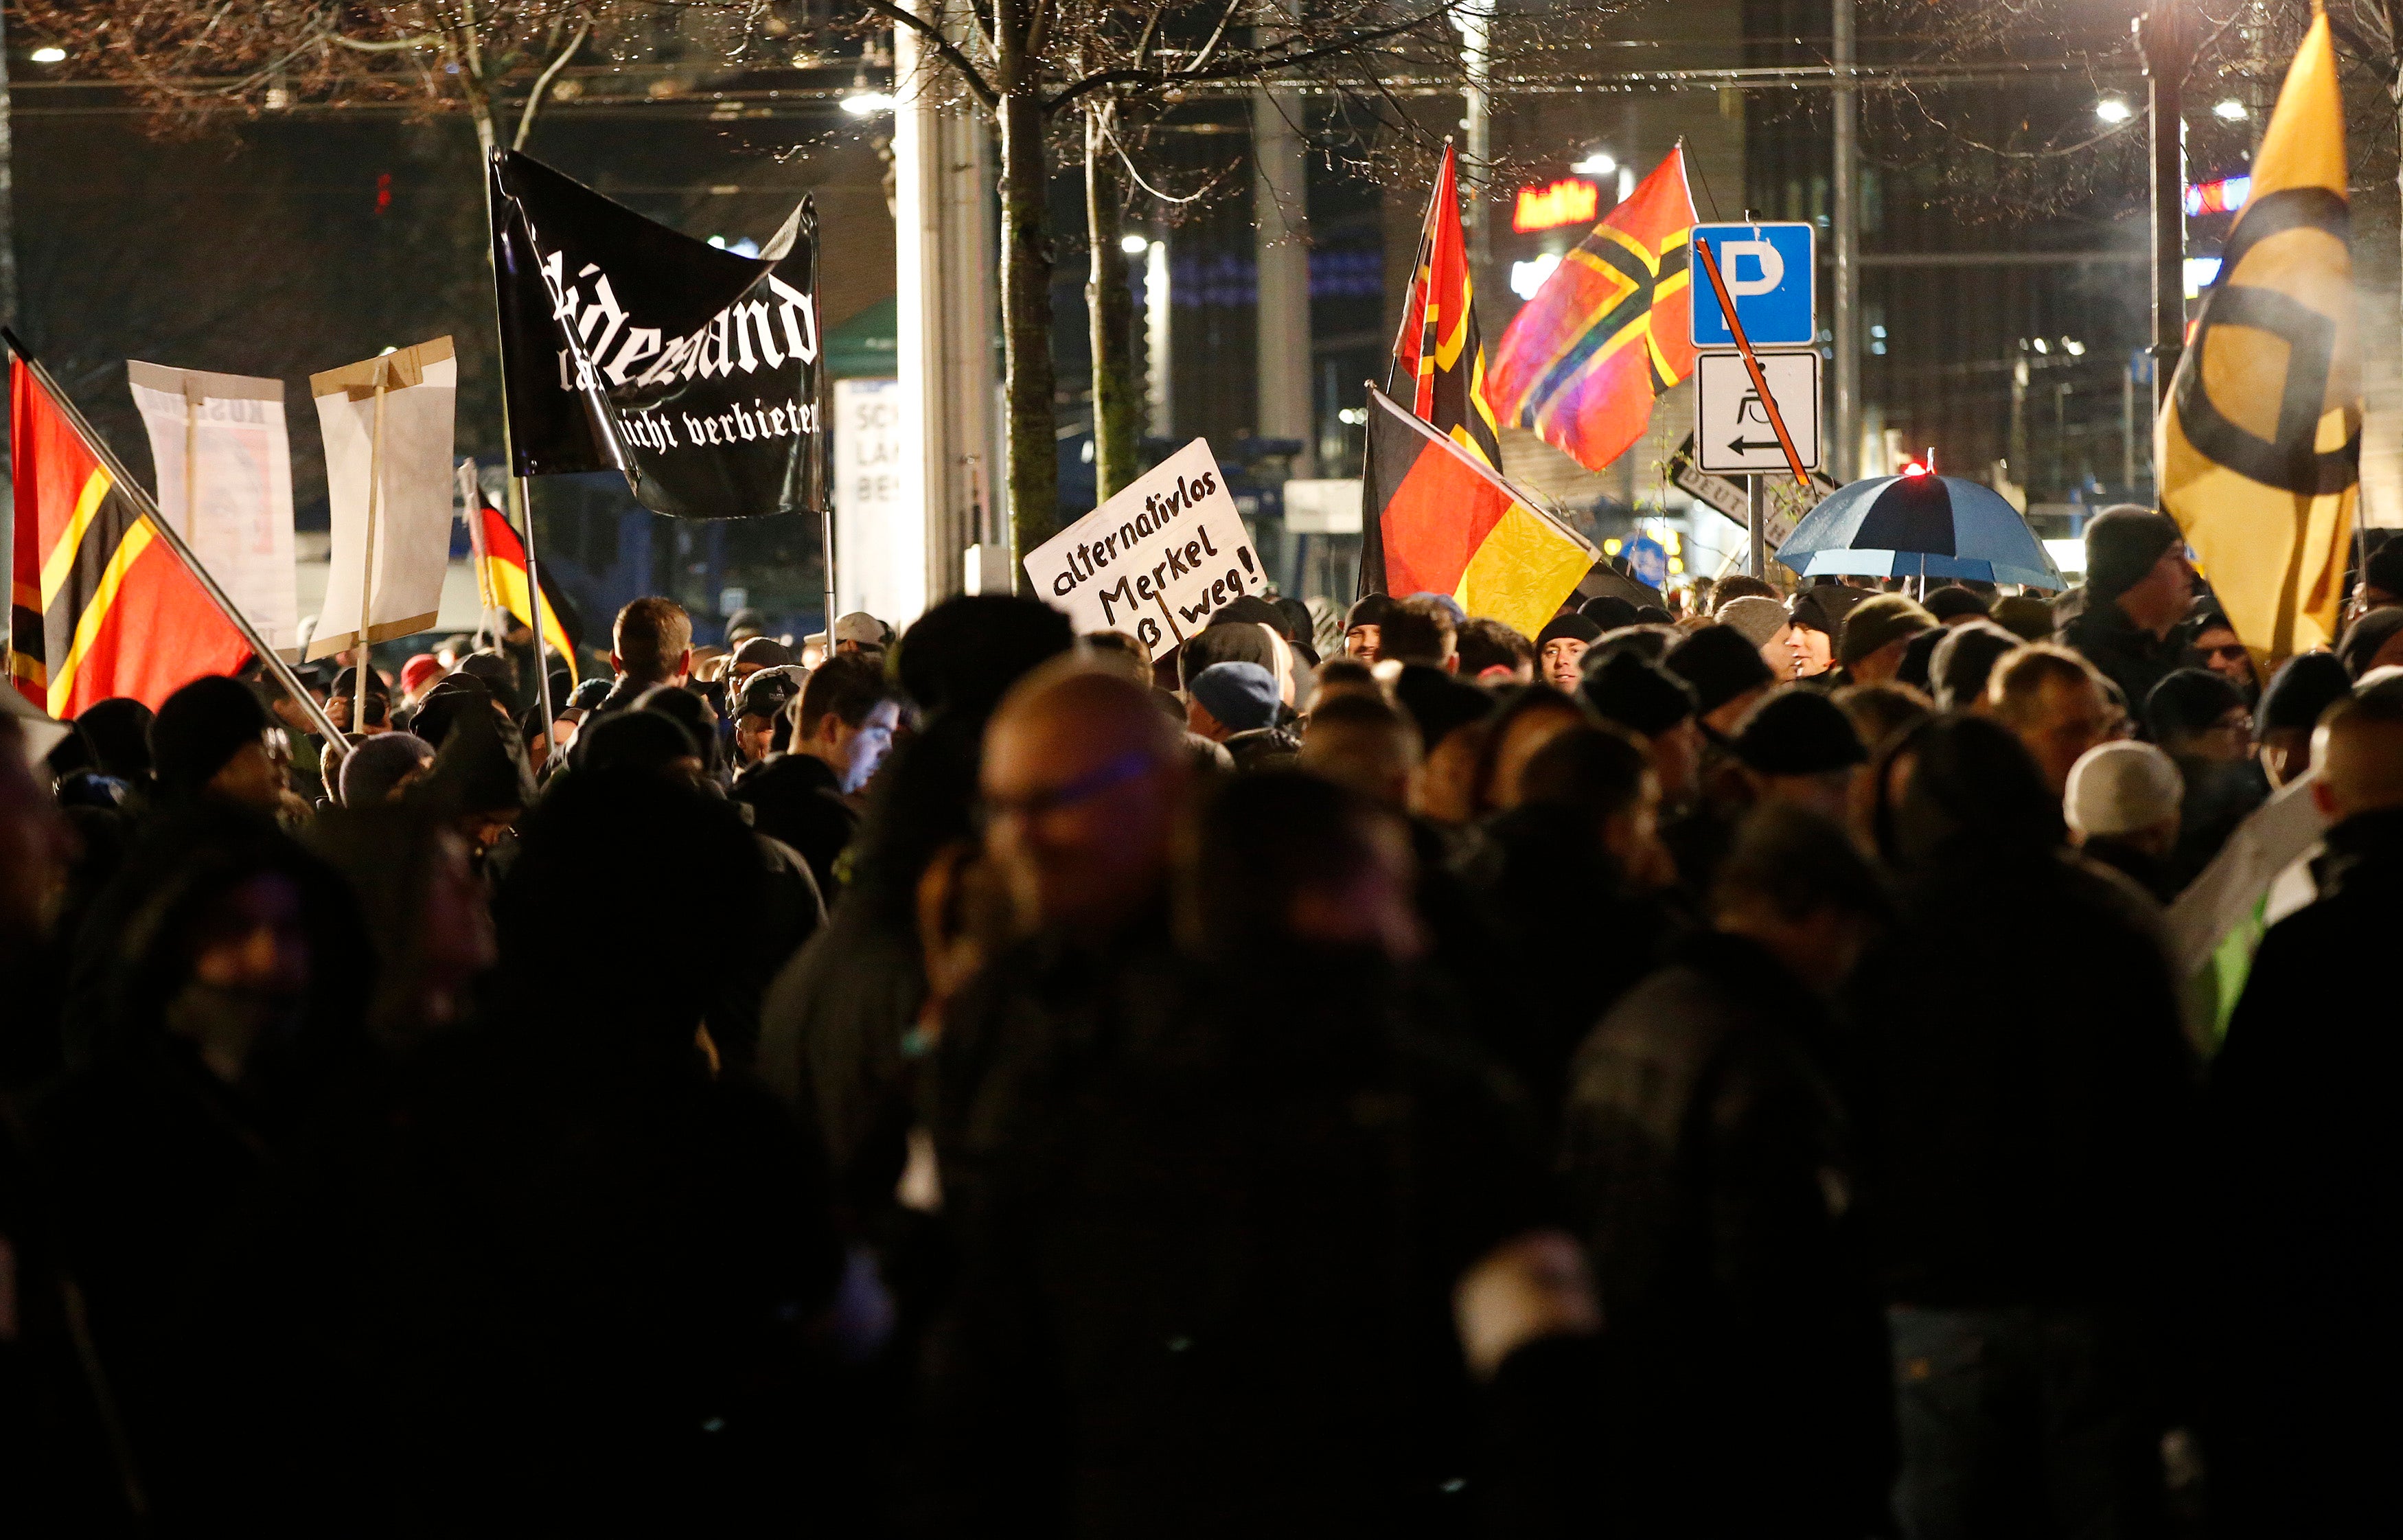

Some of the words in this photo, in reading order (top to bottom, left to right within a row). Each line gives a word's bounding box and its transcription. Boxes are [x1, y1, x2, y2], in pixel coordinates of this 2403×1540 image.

[1721, 240, 1784, 330] P
[1053, 471, 1217, 596] alternativlos
[1099, 525, 1218, 626] Merkel
